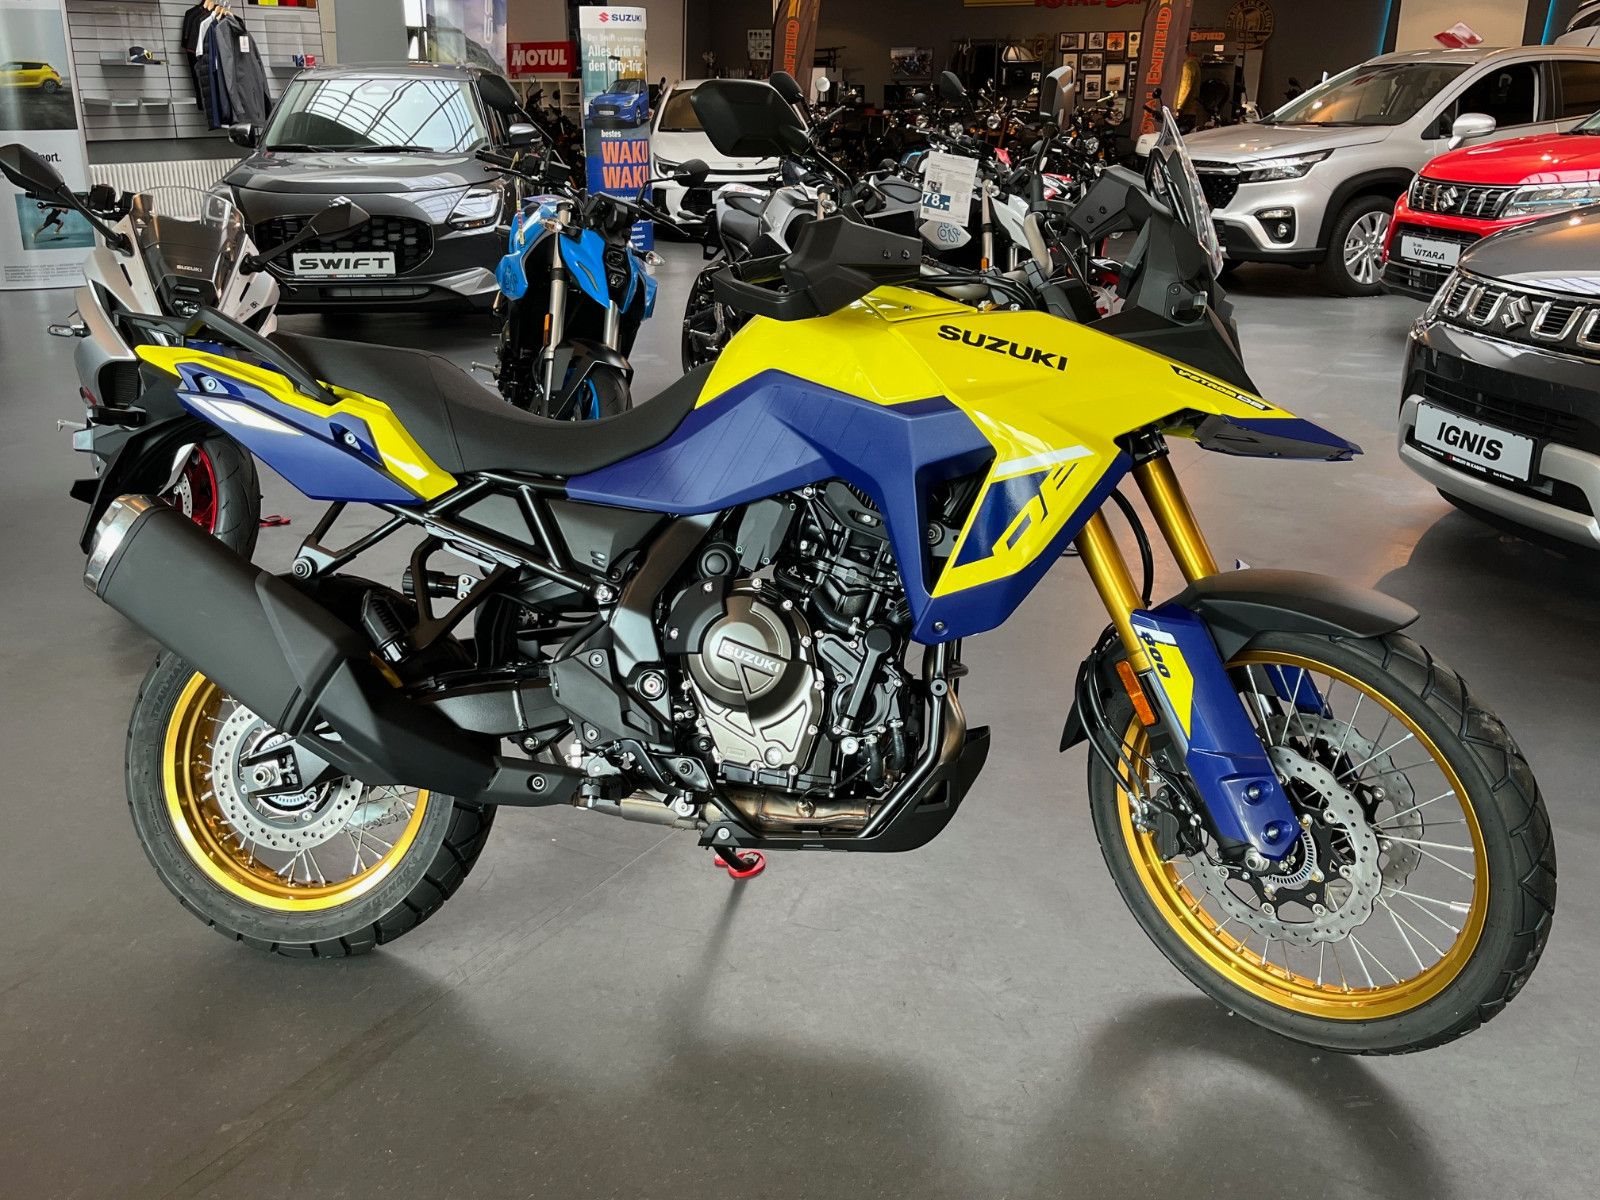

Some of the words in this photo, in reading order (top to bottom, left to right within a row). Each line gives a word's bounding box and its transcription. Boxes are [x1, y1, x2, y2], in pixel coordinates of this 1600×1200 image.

[588, 45, 611, 57] Alles
[614, 45, 631, 57] drin
[1145, 6, 1172, 85] ENFIELD
[511, 48, 567, 66] MOTUL
[588, 60, 606, 72] den
[601, 130, 622, 138] bestes
[601, 141, 648, 164] WAKU
[602, 165, 649, 189] WAKU
[299, 257, 390, 270] SWIFT
[1414, 248, 1445, 260] VITARA
[176, 264, 203, 273] SUZUKI
[937, 324, 1068, 371] SUZUKI
[1437, 421, 1503, 461] IGNIS
[722, 643, 781, 673] SUZUKI
[1140, 631, 1171, 678] 800
